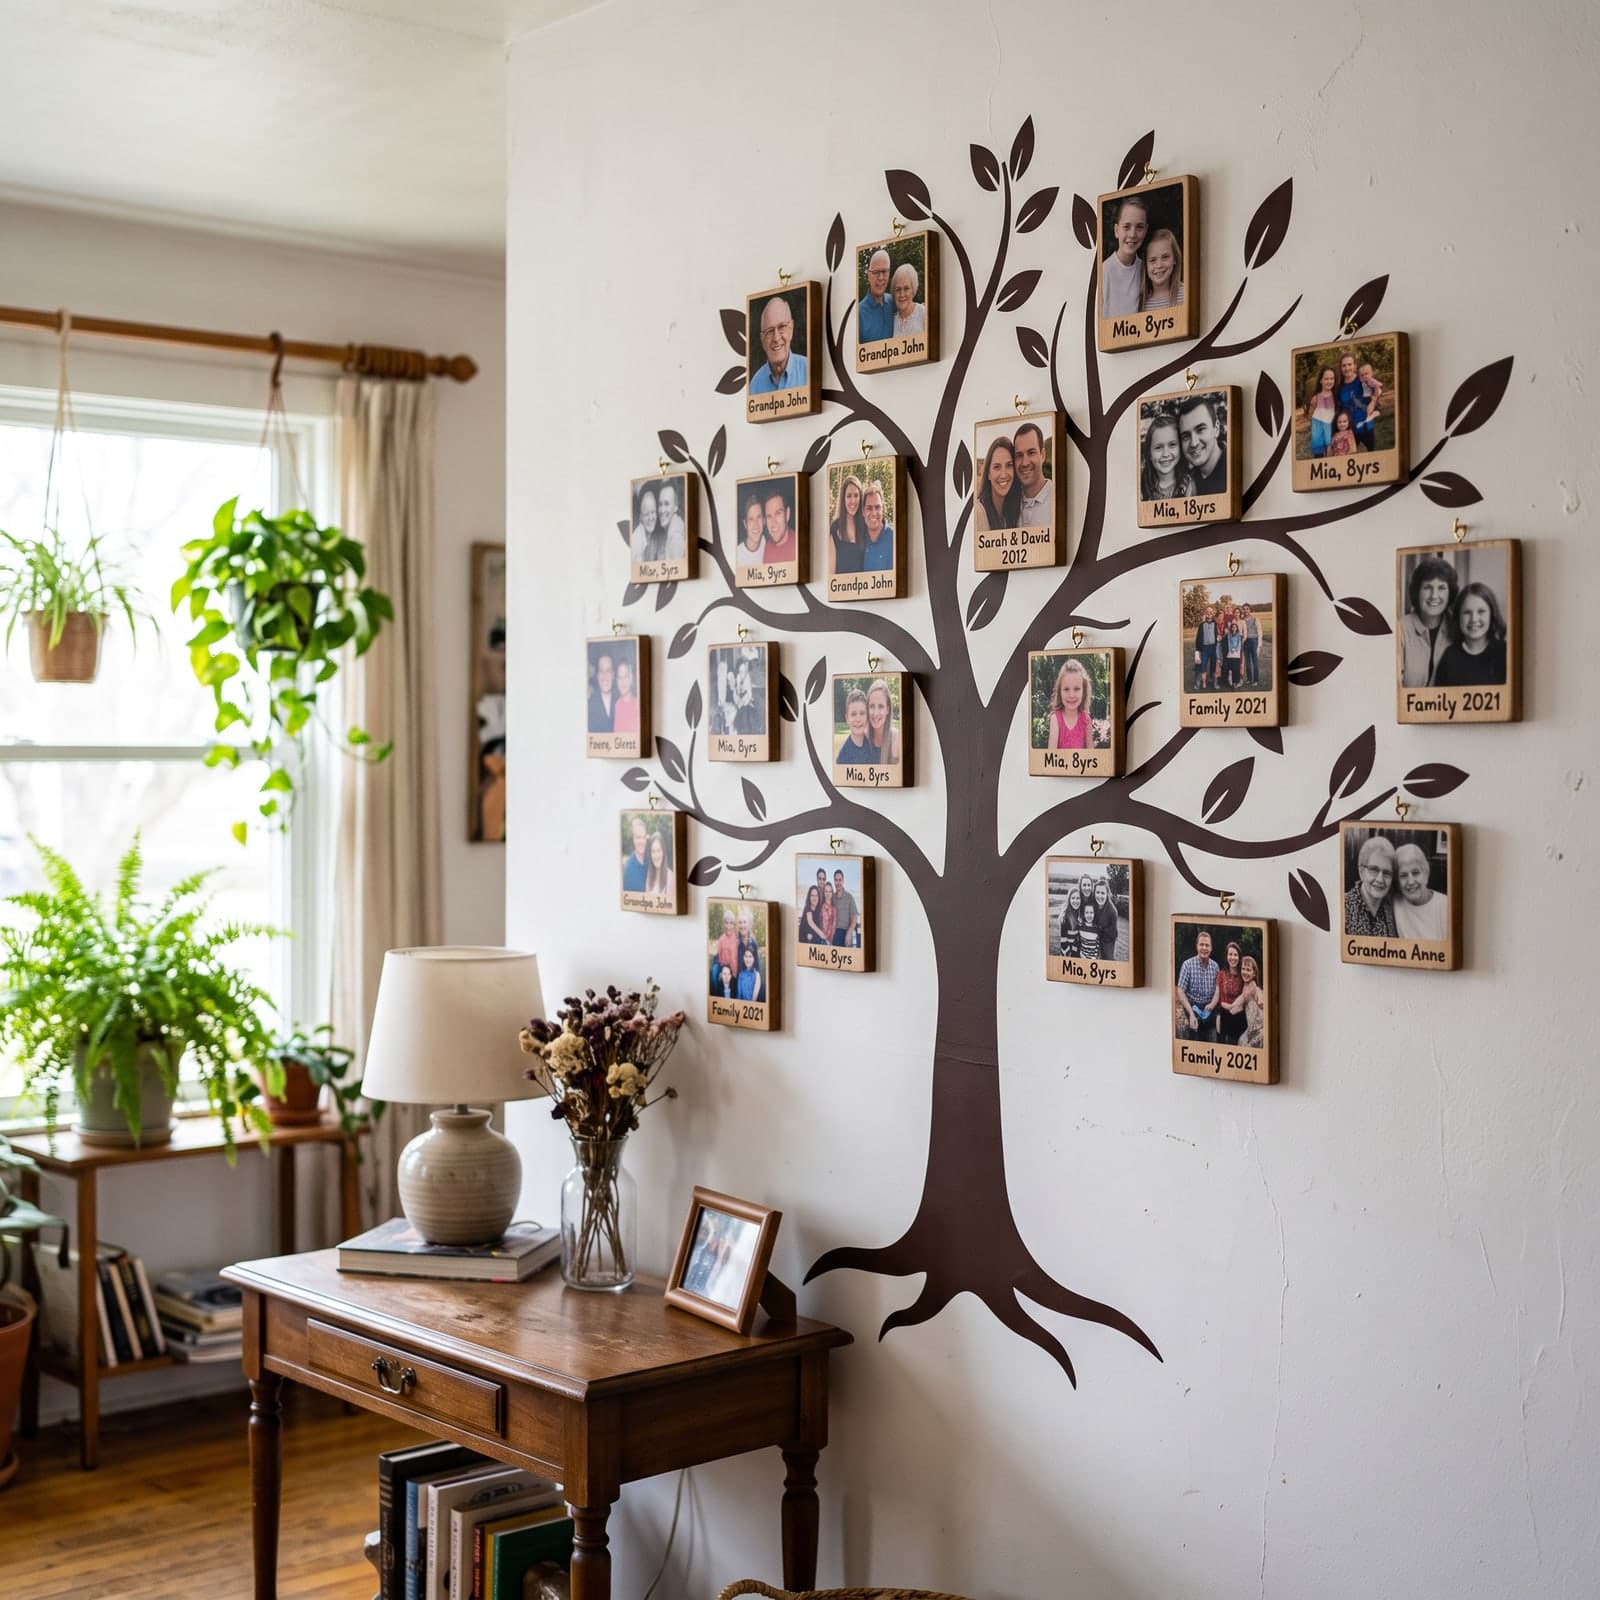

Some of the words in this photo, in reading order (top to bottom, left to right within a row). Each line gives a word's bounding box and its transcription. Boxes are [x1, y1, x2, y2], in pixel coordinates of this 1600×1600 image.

[1112, 320, 1142, 339] Mia,
[1145, 315, 1175, 339] 8yrs
[859, 347, 900, 365] Grandpa
[901, 341, 925, 354] John
[748, 398, 785, 416] Grandpa
[786, 397, 808, 408] John
[1310, 463, 1342, 482] Mia,
[1346, 459, 1381, 482] 8yrs
[1153, 504, 1181, 519] Mia,
[1183, 500, 1217, 521] 18yrs
[978, 533, 1008, 549] Sarah
[1011, 532, 1019, 547] &
[1021, 529, 1051, 545] David
[1002, 549, 1028, 565] 2012
[747, 568, 766, 581] Mia,
[768, 567, 788, 584] 9yrs
[831, 579, 870, 596] Grandpa
[871, 576, 894, 590] John
[1189, 699, 1231, 723] Family
[1235, 697, 1268, 716] 2021
[1407, 694, 1458, 720] Family
[1462, 692, 1502, 712] 2021
[718, 740, 737, 753] Mia,
[738, 740, 758, 759] 8yrs
[1044, 754, 1069, 771] Mia,
[1072, 753, 1099, 776] 8yrs
[846, 768, 867, 783] Mia,
[869, 768, 890, 787] 8yrs
[809, 947, 829, 965] Mia,
[831, 950, 853, 969] 8yrs
[1347, 940, 1408, 961] Grandma
[1411, 943, 1446, 963] Anne
[1063, 960, 1088, 979] Mia,
[1090, 962, 1117, 985] 8yrs
[712, 1001, 741, 1024] Family
[743, 1005, 764, 1022] 2021
[1181, 1046, 1224, 1073] Family
[1227, 1051, 1259, 1072] 2021
